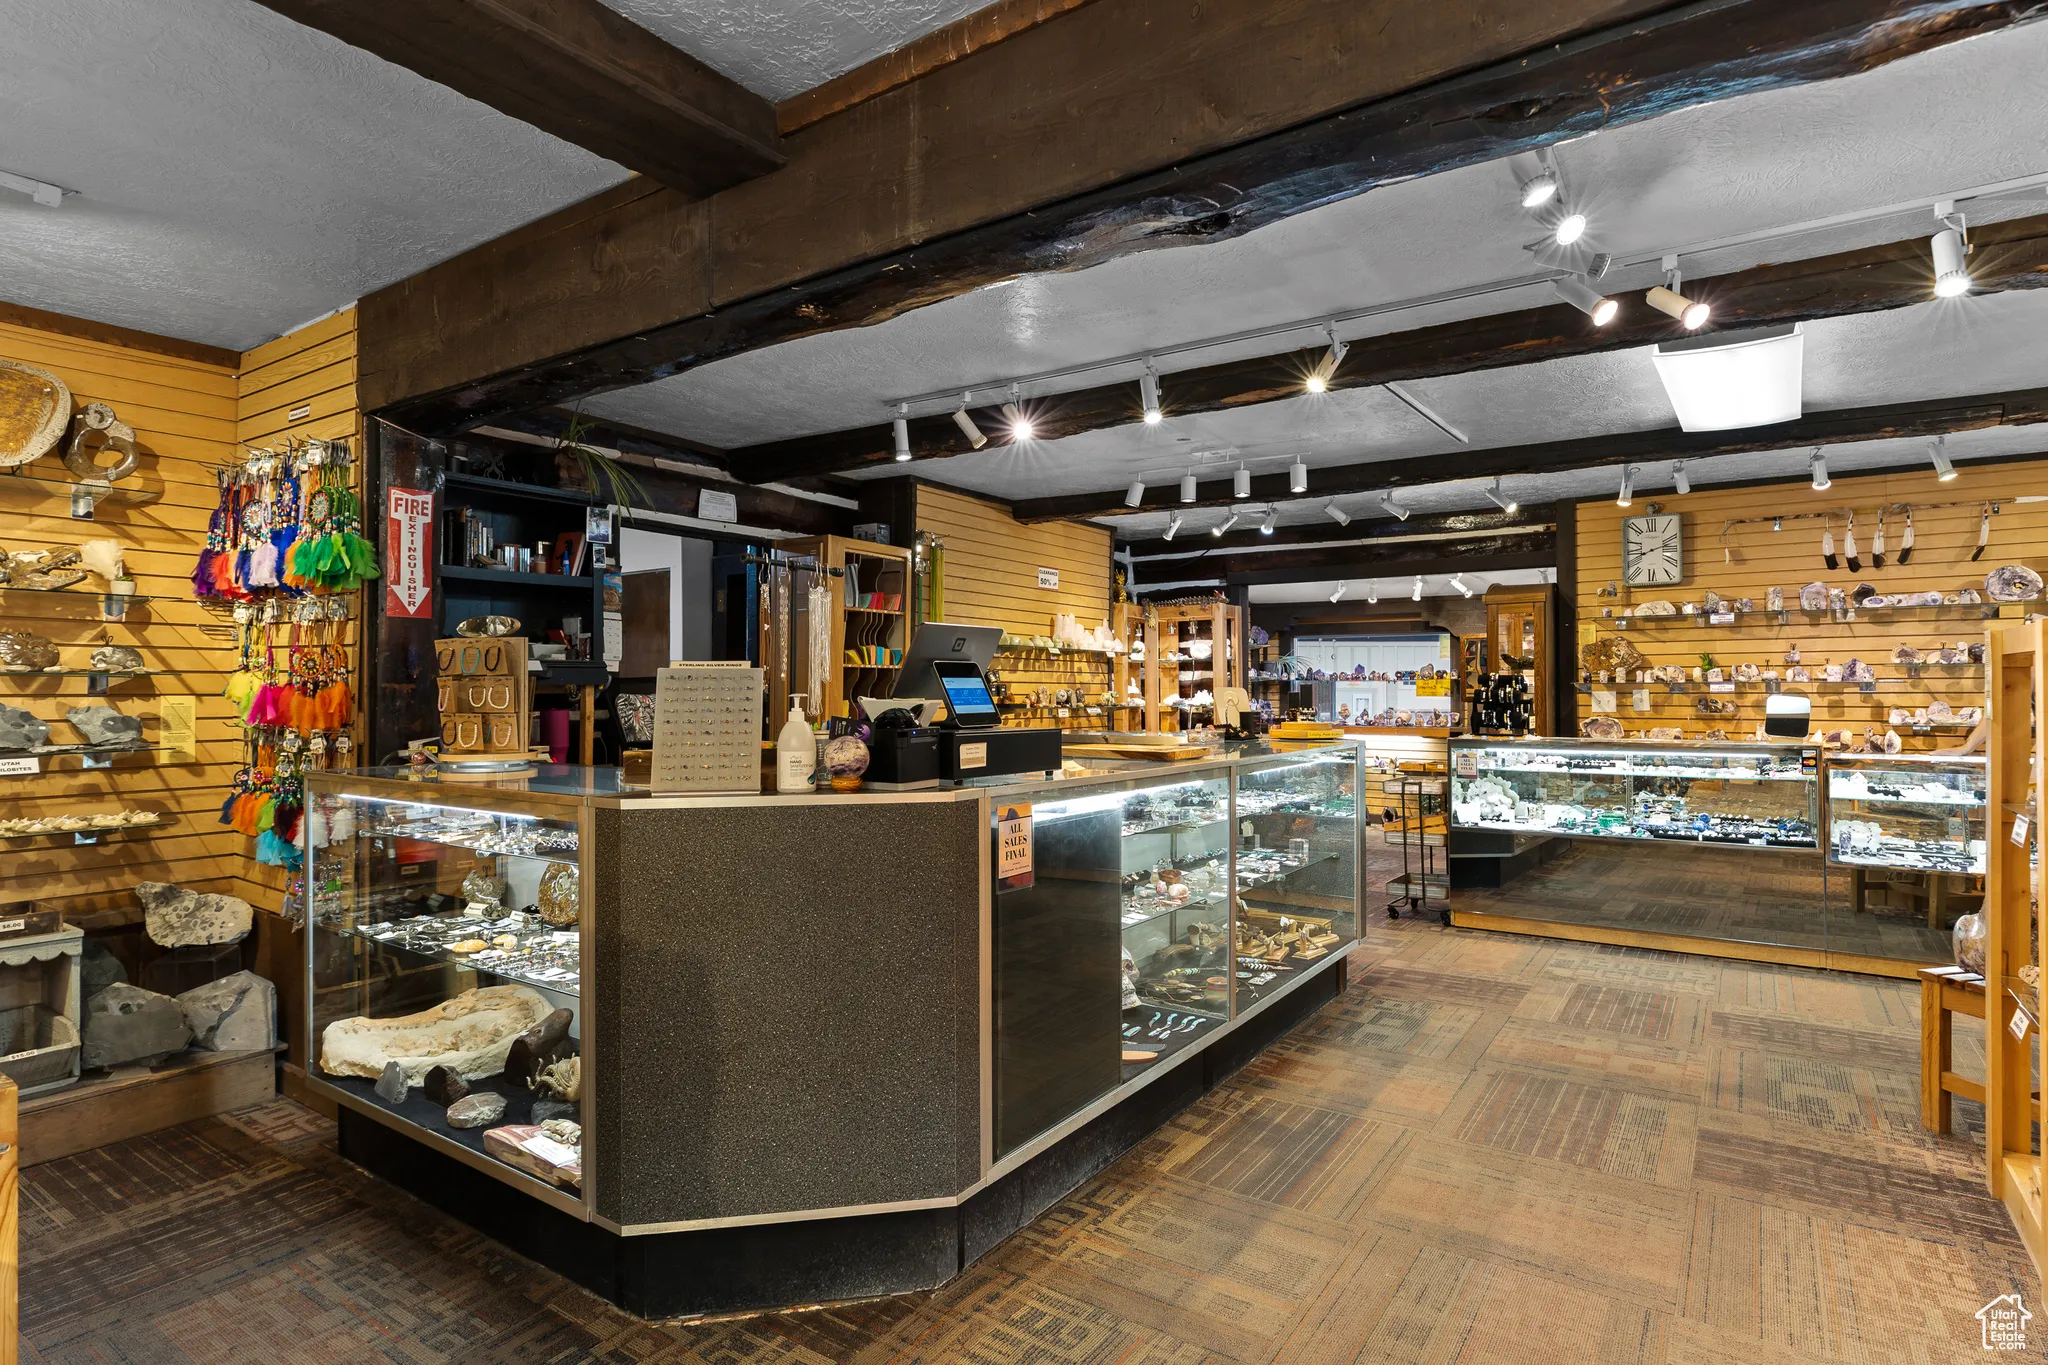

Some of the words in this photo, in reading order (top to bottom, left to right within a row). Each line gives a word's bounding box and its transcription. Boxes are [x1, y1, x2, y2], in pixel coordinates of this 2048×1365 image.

[394, 496, 429, 517] FIRE
[1645, 518, 1657, 533] XII
[407, 515, 417, 607] EXTINGUISHER
[1038, 569, 1058, 577] CLEARANCE
[1040, 577, 1051, 586] 50%
[1009, 823, 1023, 834] ALL
[1004, 834, 1028, 849] SALES
[1005, 847, 1027, 861] FINAL
